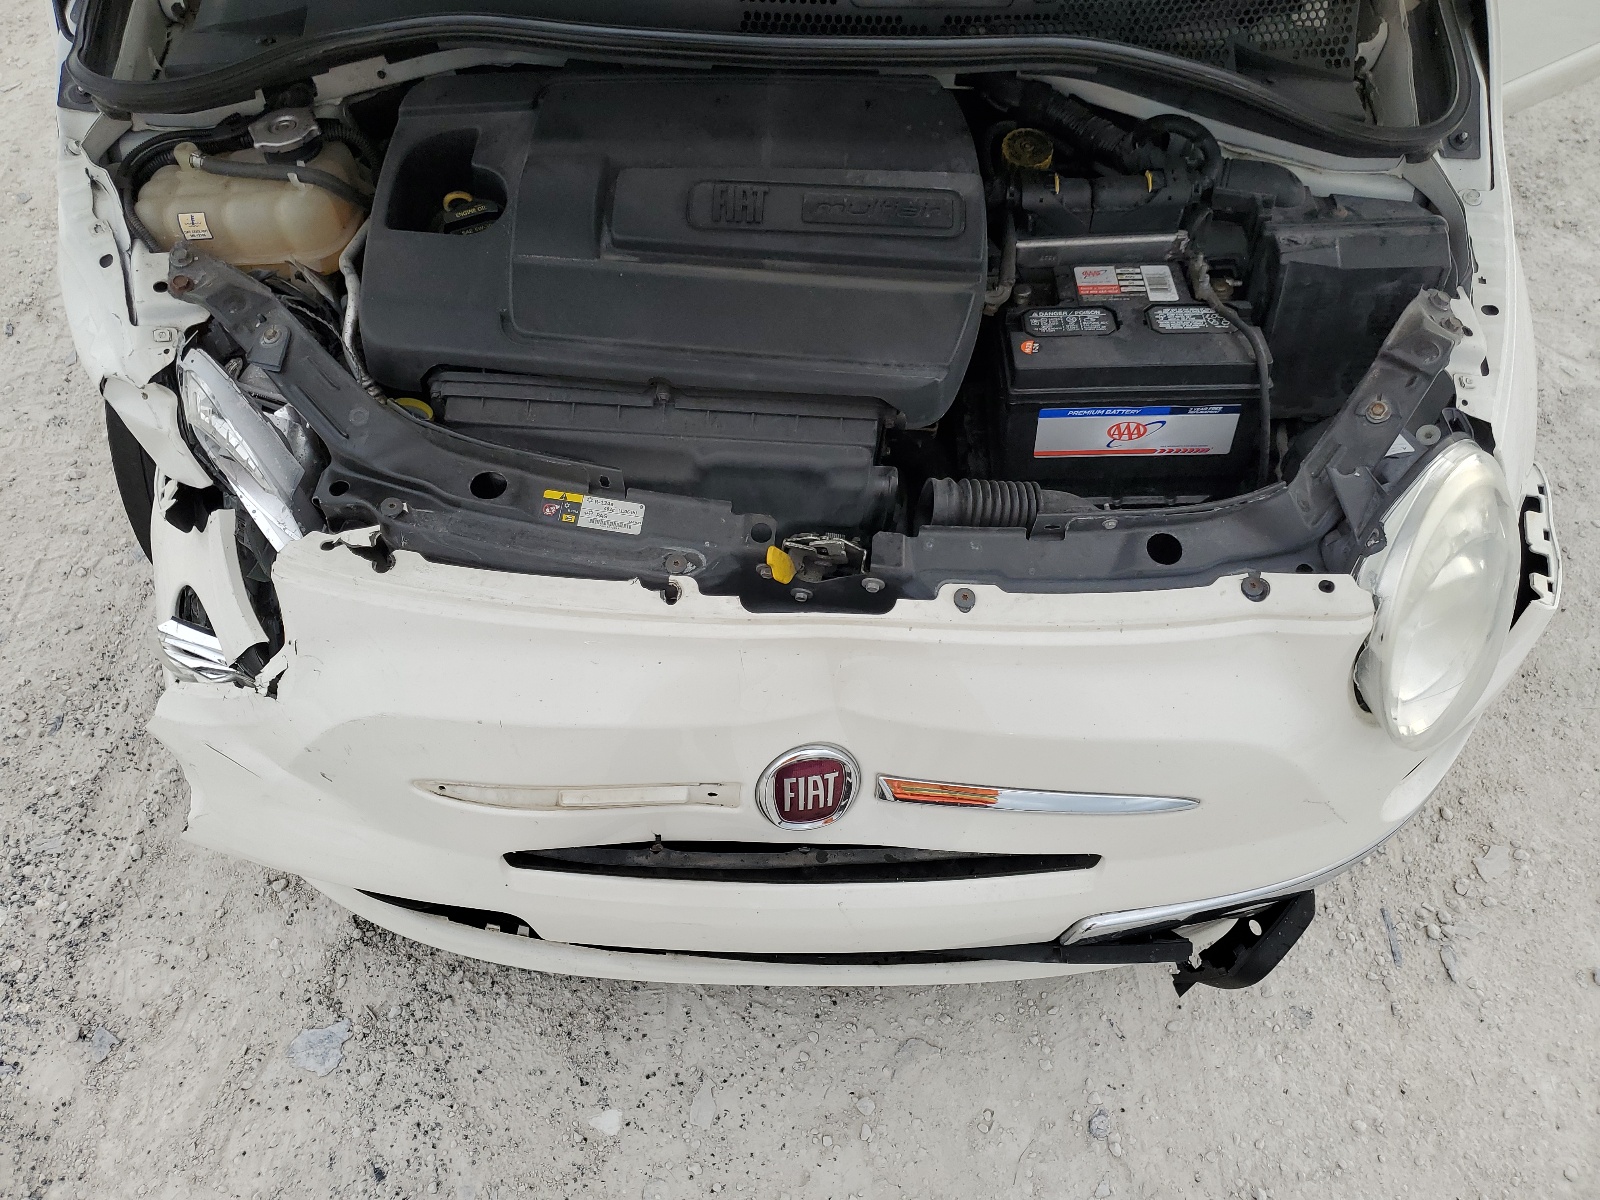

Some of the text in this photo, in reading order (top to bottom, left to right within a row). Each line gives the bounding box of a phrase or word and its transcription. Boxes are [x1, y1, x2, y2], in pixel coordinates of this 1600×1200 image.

[455, 208, 477, 217] ENGINE
[711, 184, 770, 224] FIAT
[1110, 422, 1144, 441] AAA
[783, 771, 839, 812] FIAT
